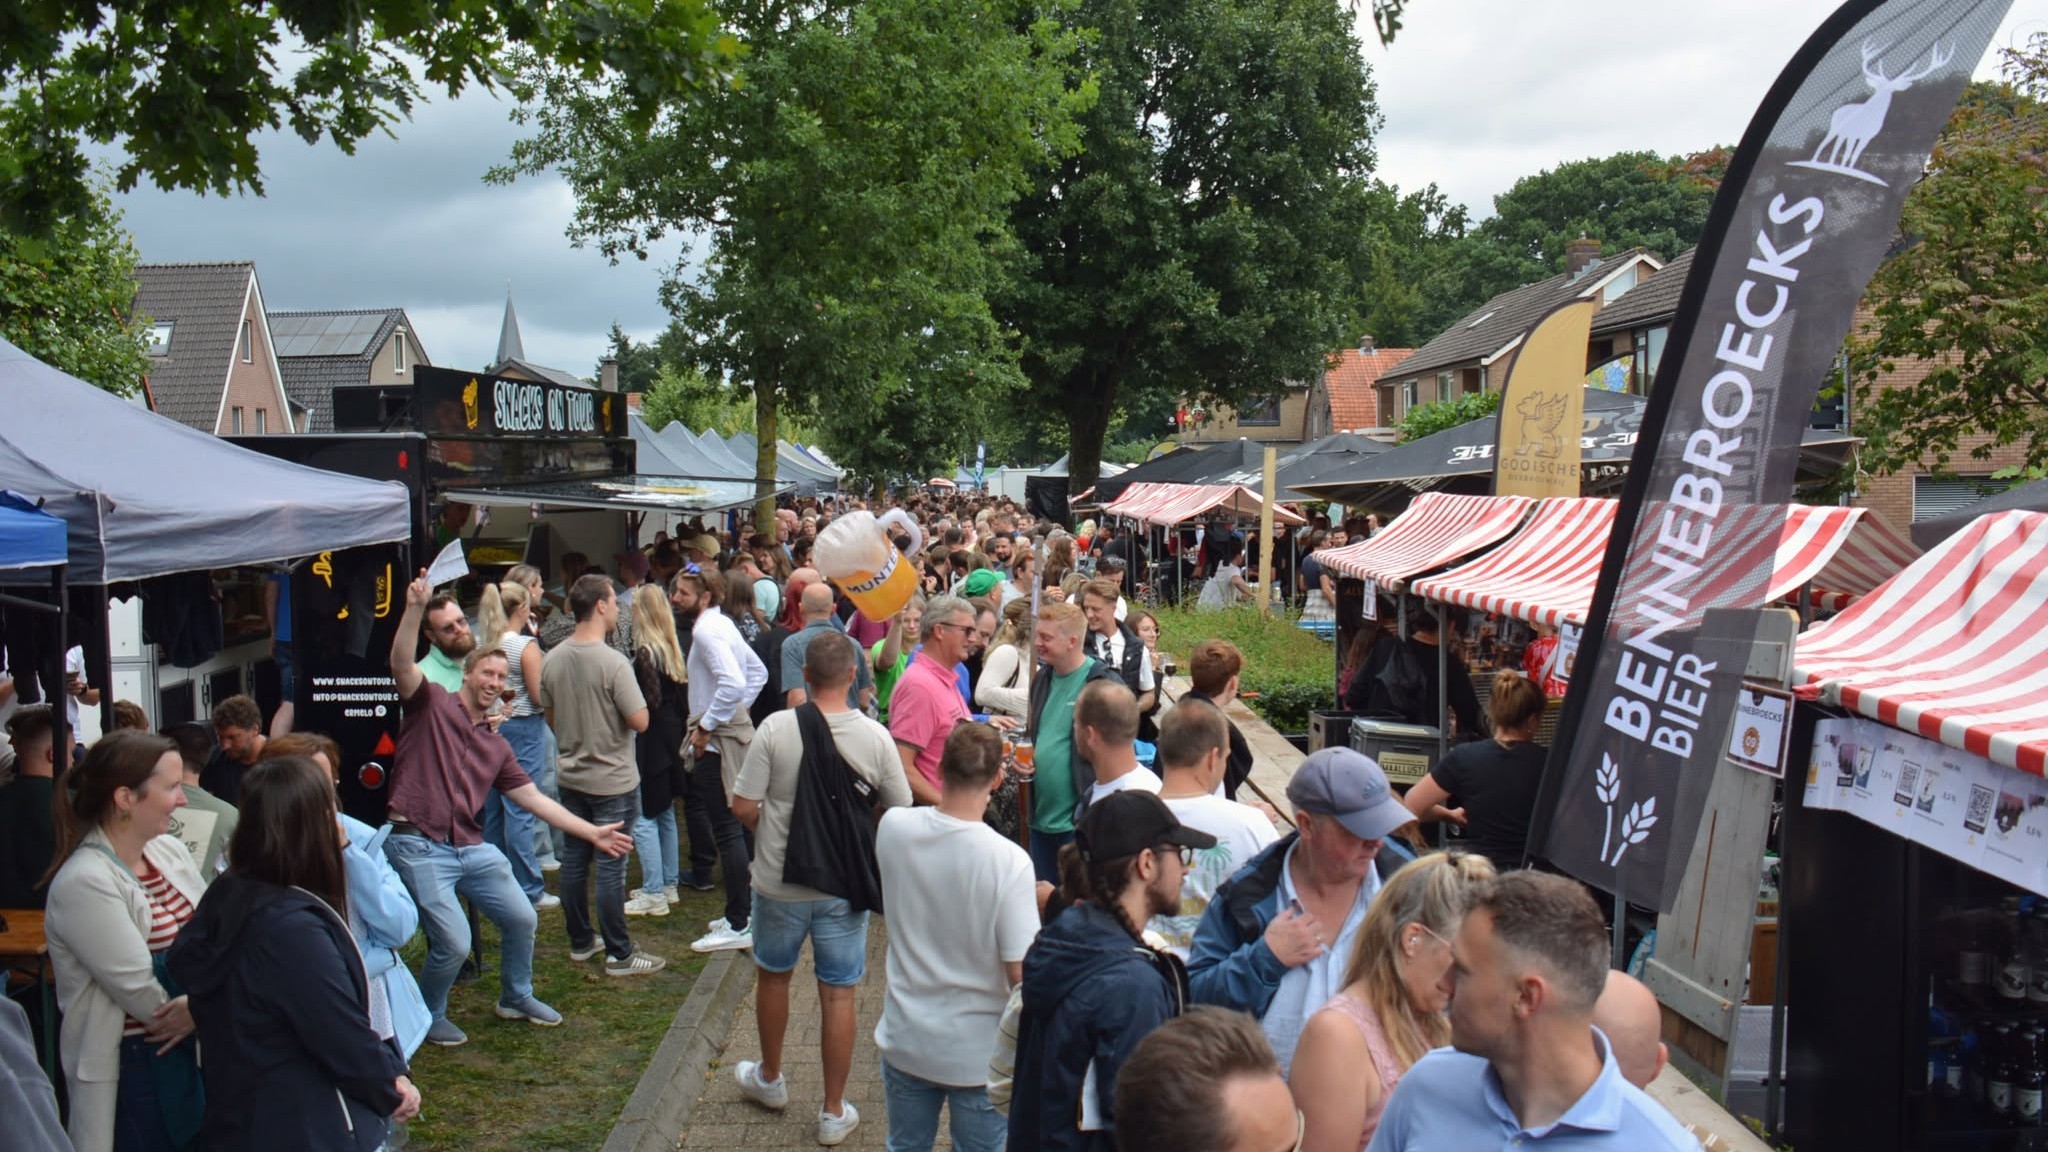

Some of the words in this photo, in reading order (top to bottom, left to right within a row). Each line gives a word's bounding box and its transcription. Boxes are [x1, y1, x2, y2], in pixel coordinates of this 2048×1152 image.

[494, 380, 544, 431] SNACKS
[548, 388, 565, 431] ON
[566, 389, 595, 432] TOUR
[1500, 457, 1577, 477] GOOISCHE
[1604, 192, 1824, 742] BENNEBROECKS
[1651, 653, 1718, 759] BIER
